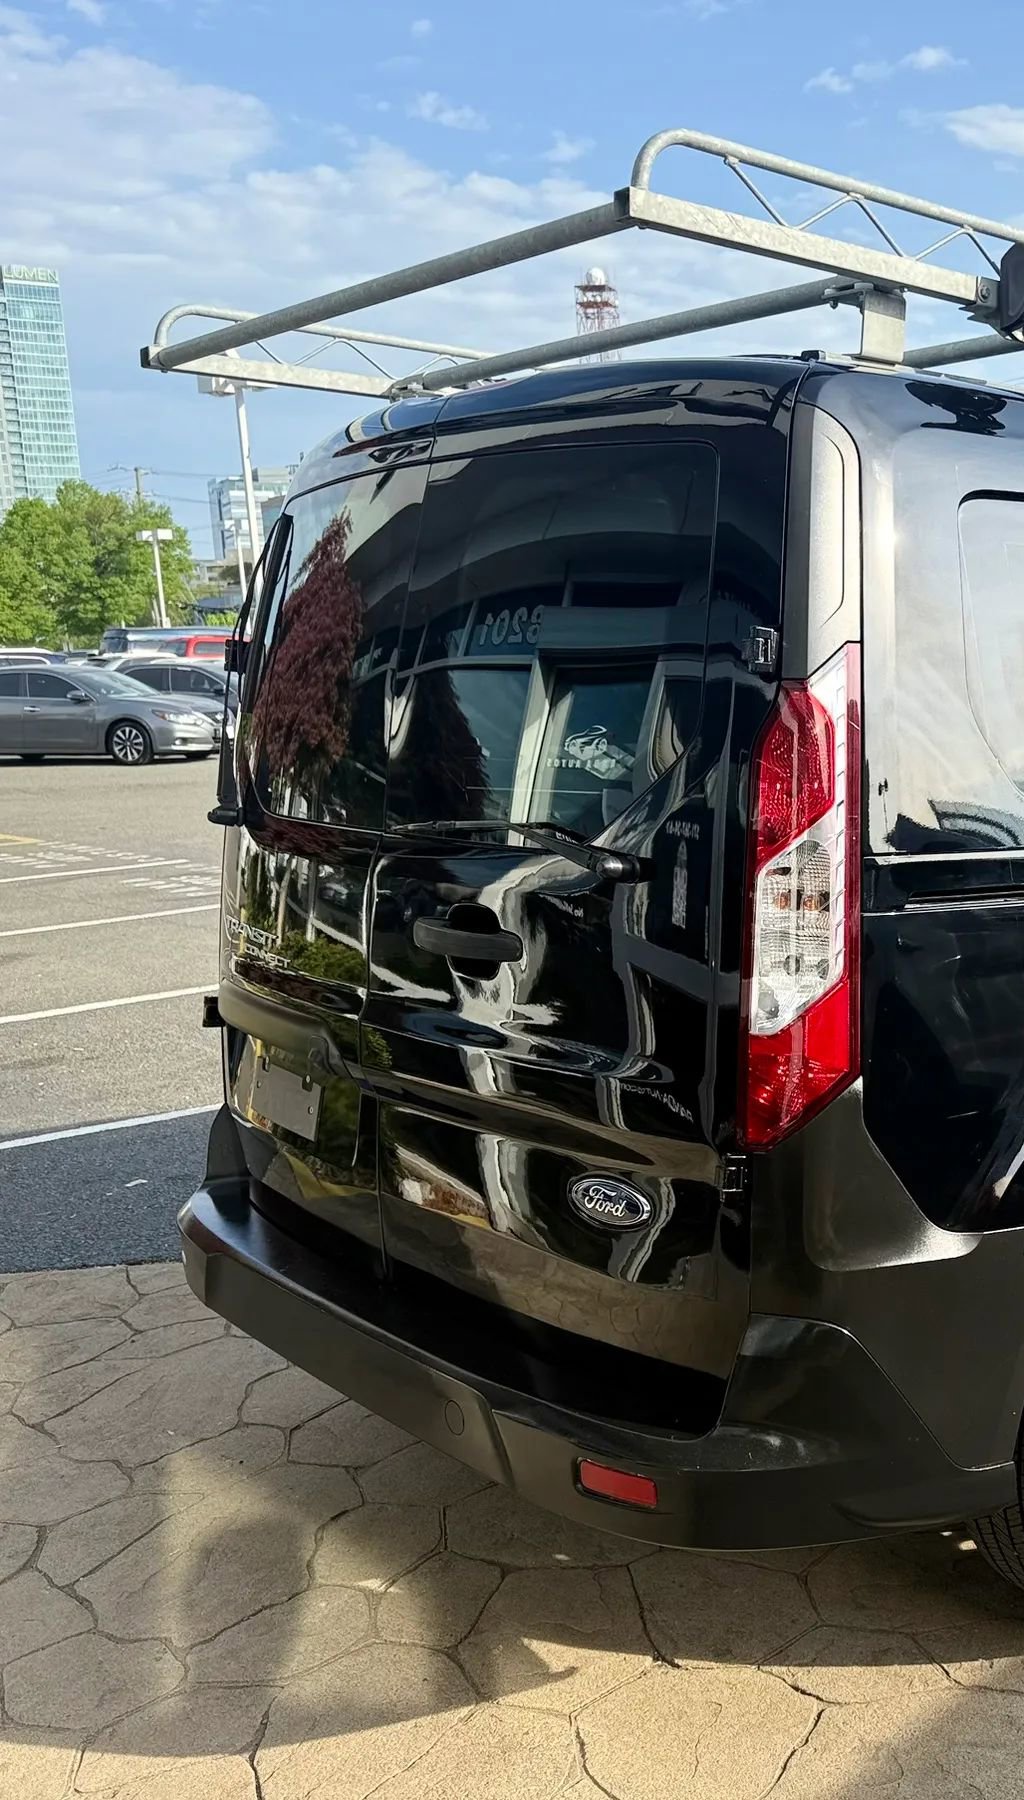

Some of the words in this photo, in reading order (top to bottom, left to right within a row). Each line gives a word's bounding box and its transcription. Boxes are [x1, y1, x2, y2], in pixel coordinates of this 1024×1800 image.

[3, 265, 59, 284] LUMEN
[226, 914, 279, 951] TRANSIT
[244, 943, 292, 969] CONNECT
[584, 1186, 627, 1217] Ford
